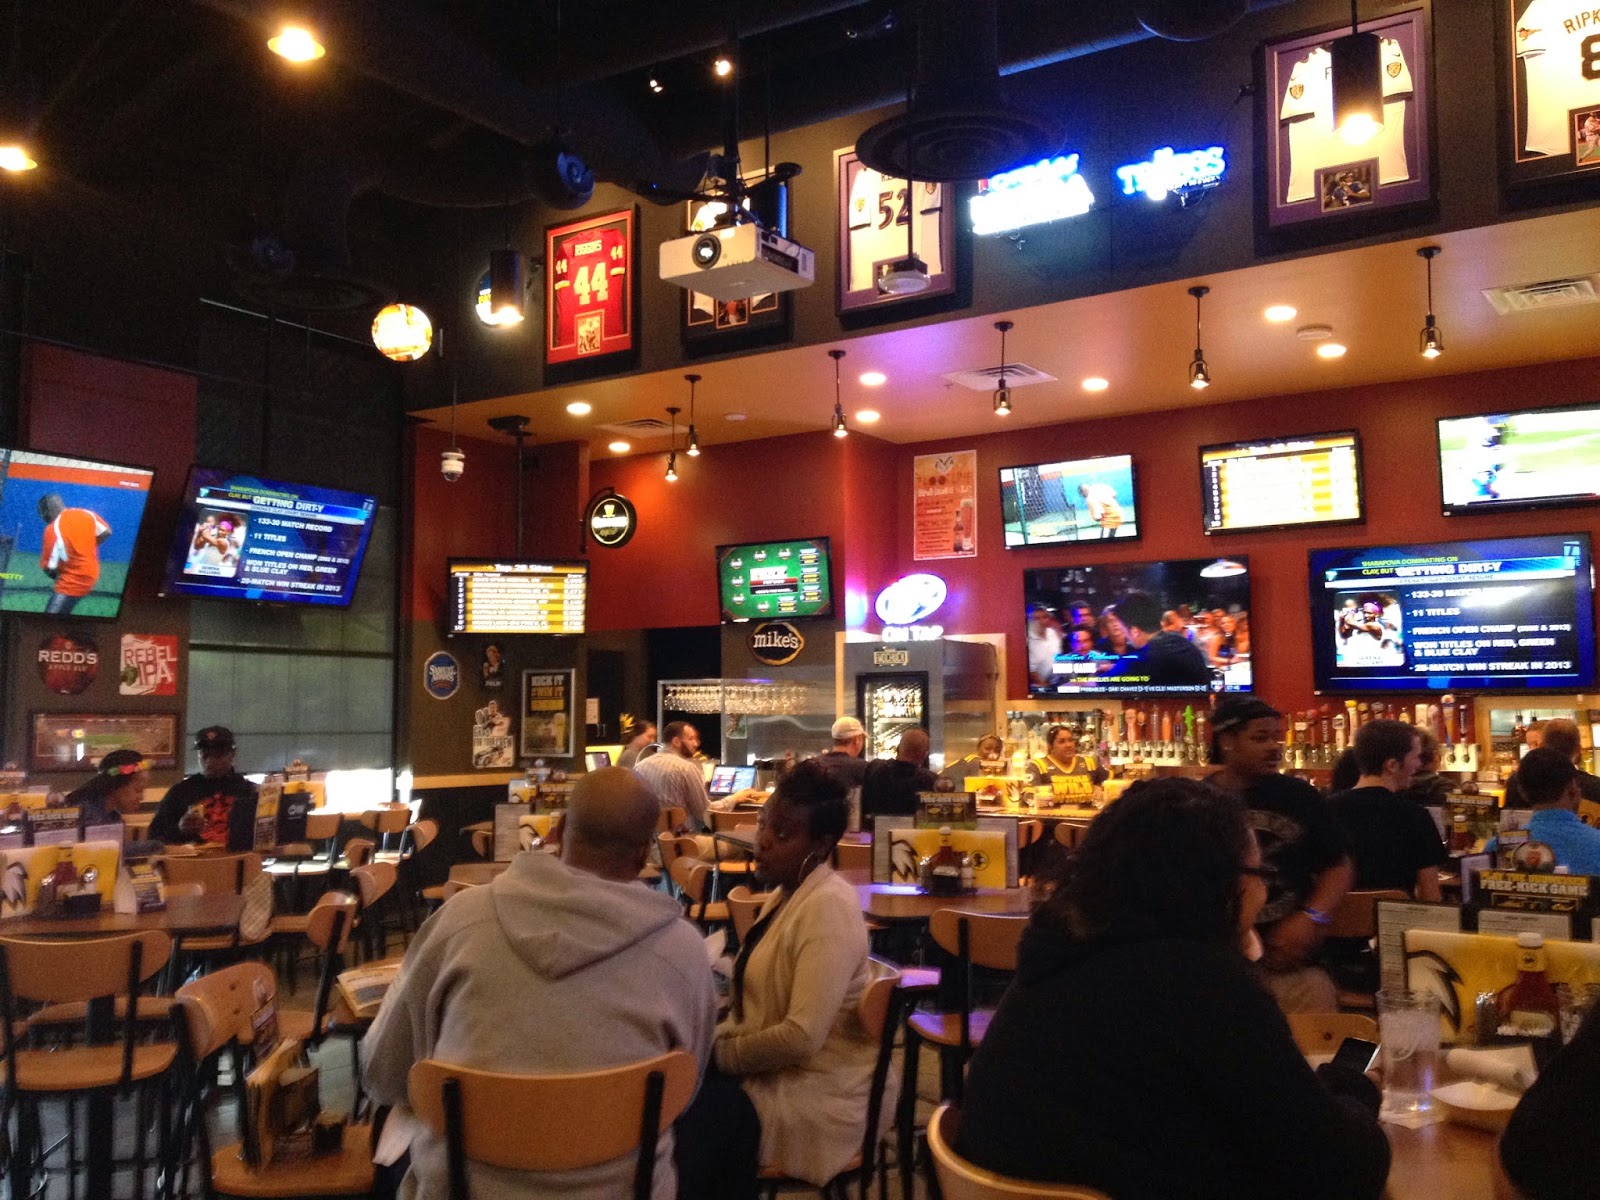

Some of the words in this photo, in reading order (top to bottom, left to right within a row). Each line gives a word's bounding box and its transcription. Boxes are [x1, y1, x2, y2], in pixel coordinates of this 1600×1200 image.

[878, 188, 912, 231] 52
[610, 245, 624, 260] 44
[555, 258, 568, 275] 44
[573, 262, 609, 306] 44
[252, 495, 294, 509] GETTING
[280, 520, 305, 530] MATCH
[305, 523, 333, 533] RECORD
[263, 532, 287, 542] TITLES
[248, 547, 276, 557] FRENCH
[276, 550, 295, 559] OPEN
[294, 552, 318, 561] CHAMP
[245, 559, 263, 567] WON
[264, 560, 287, 569] TITLES
[314, 566, 338, 574] GREEN
[251, 566, 270, 574] BLUE
[270, 567, 289, 576] CLAY
[1380, 567, 1394, 575] BUT
[275, 580, 290, 588] WIN
[290, 581, 316, 590] STREAK
[1412, 608, 1424, 617] 11
[1425, 607, 1461, 616] TITLES
[881, 625, 909, 642] ON
[1451, 625, 1479, 634] OPEN
[752, 630, 799, 649] mike's
[1413, 641, 1438, 649] WON
[1438, 640, 1473, 649] TITLES
[1474, 639, 1491, 648] ON
[124, 645, 178, 666] REBEL
[1451, 647, 1479, 656] CLAY
[1465, 662, 1487, 671] WIN
[1487, 661, 1529, 671] STREAK
[1530, 660, 1543, 670] IN
[1544, 660, 1572, 670] 2013
[140, 660, 174, 686] IPA
[1110, 675, 1121, 683] ARE
[553, 674, 564, 686] IT
[1480, 879, 1548, 894] FREE-KICK
[1549, 883, 1588, 896] GAME
